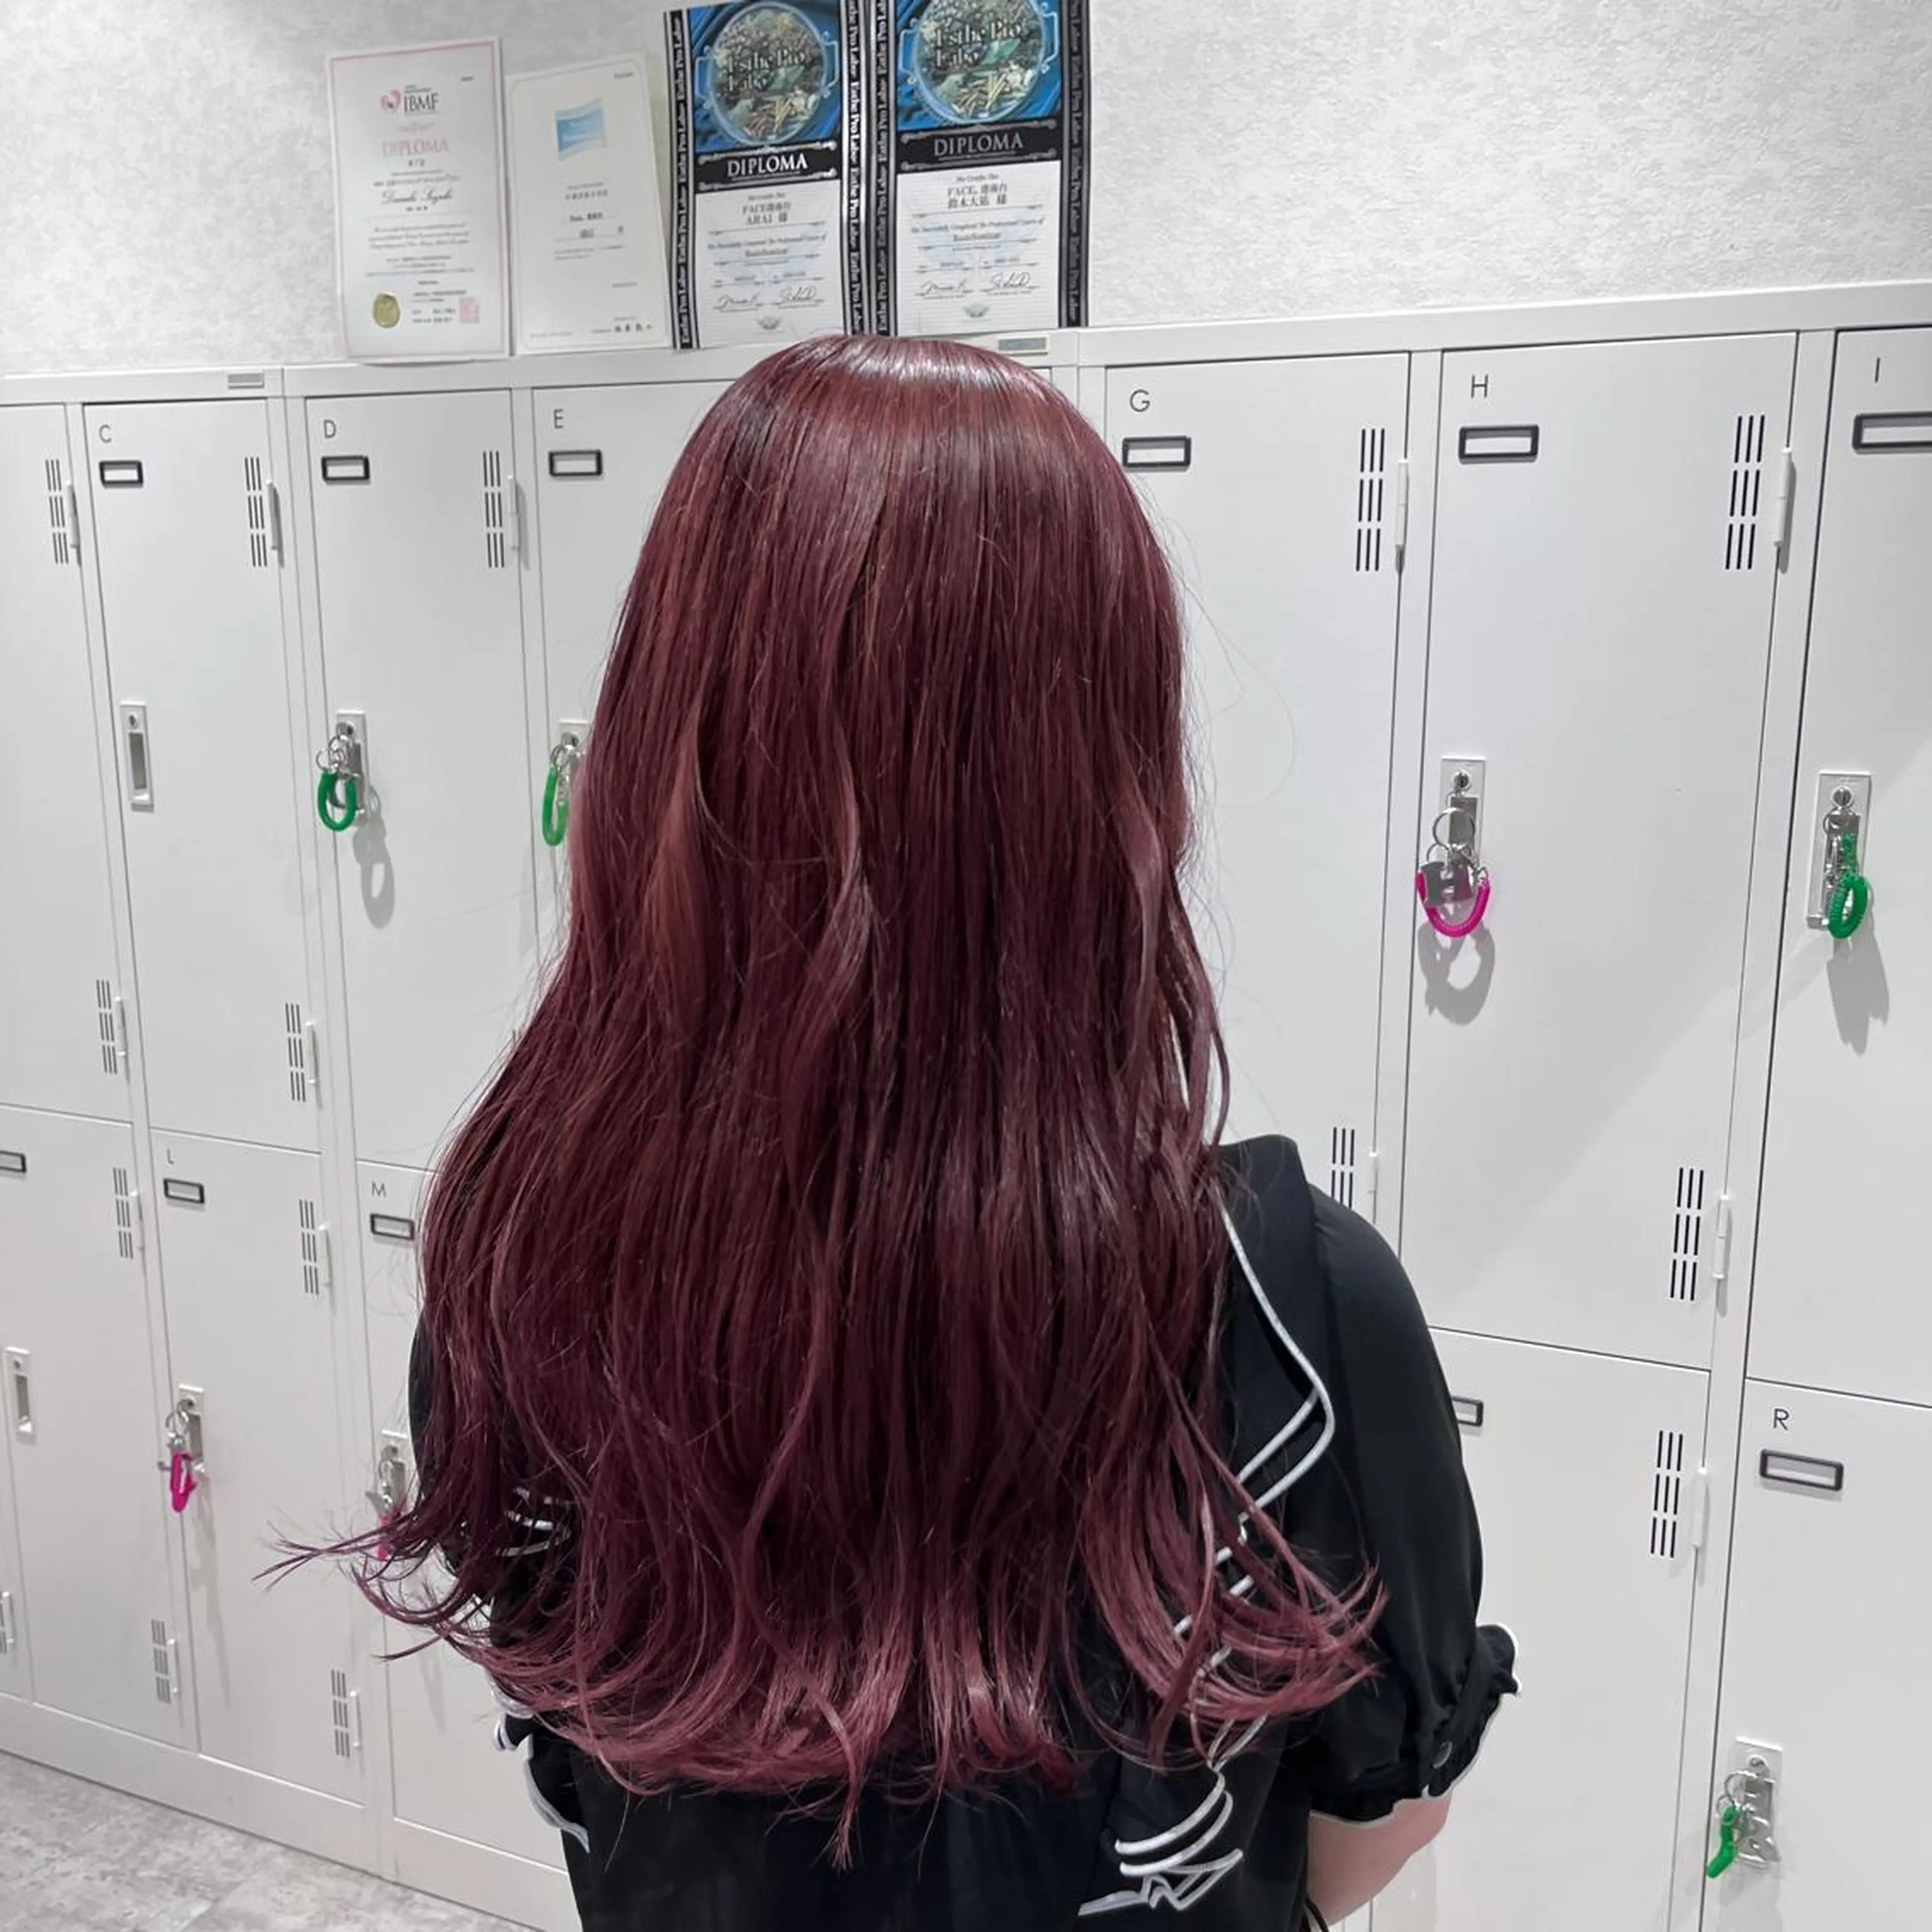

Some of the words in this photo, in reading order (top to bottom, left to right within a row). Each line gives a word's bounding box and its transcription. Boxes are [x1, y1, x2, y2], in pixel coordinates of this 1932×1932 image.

[382, 137, 450, 157] DIPLOMA
[934, 132, 1024, 156] DIPLOMA
[727, 152, 808, 177] DIPLOMA
[1874, 358, 1881, 383] I
[1471, 375, 1488, 398] H
[1130, 389, 1150, 413] G
[323, 419, 337, 439] D
[553, 409, 564, 429] E
[99, 424, 112, 443] C
[167, 1149, 174, 1165] L
[371, 1183, 387, 1197] M
[1774, 1408, 1789, 1430] R
